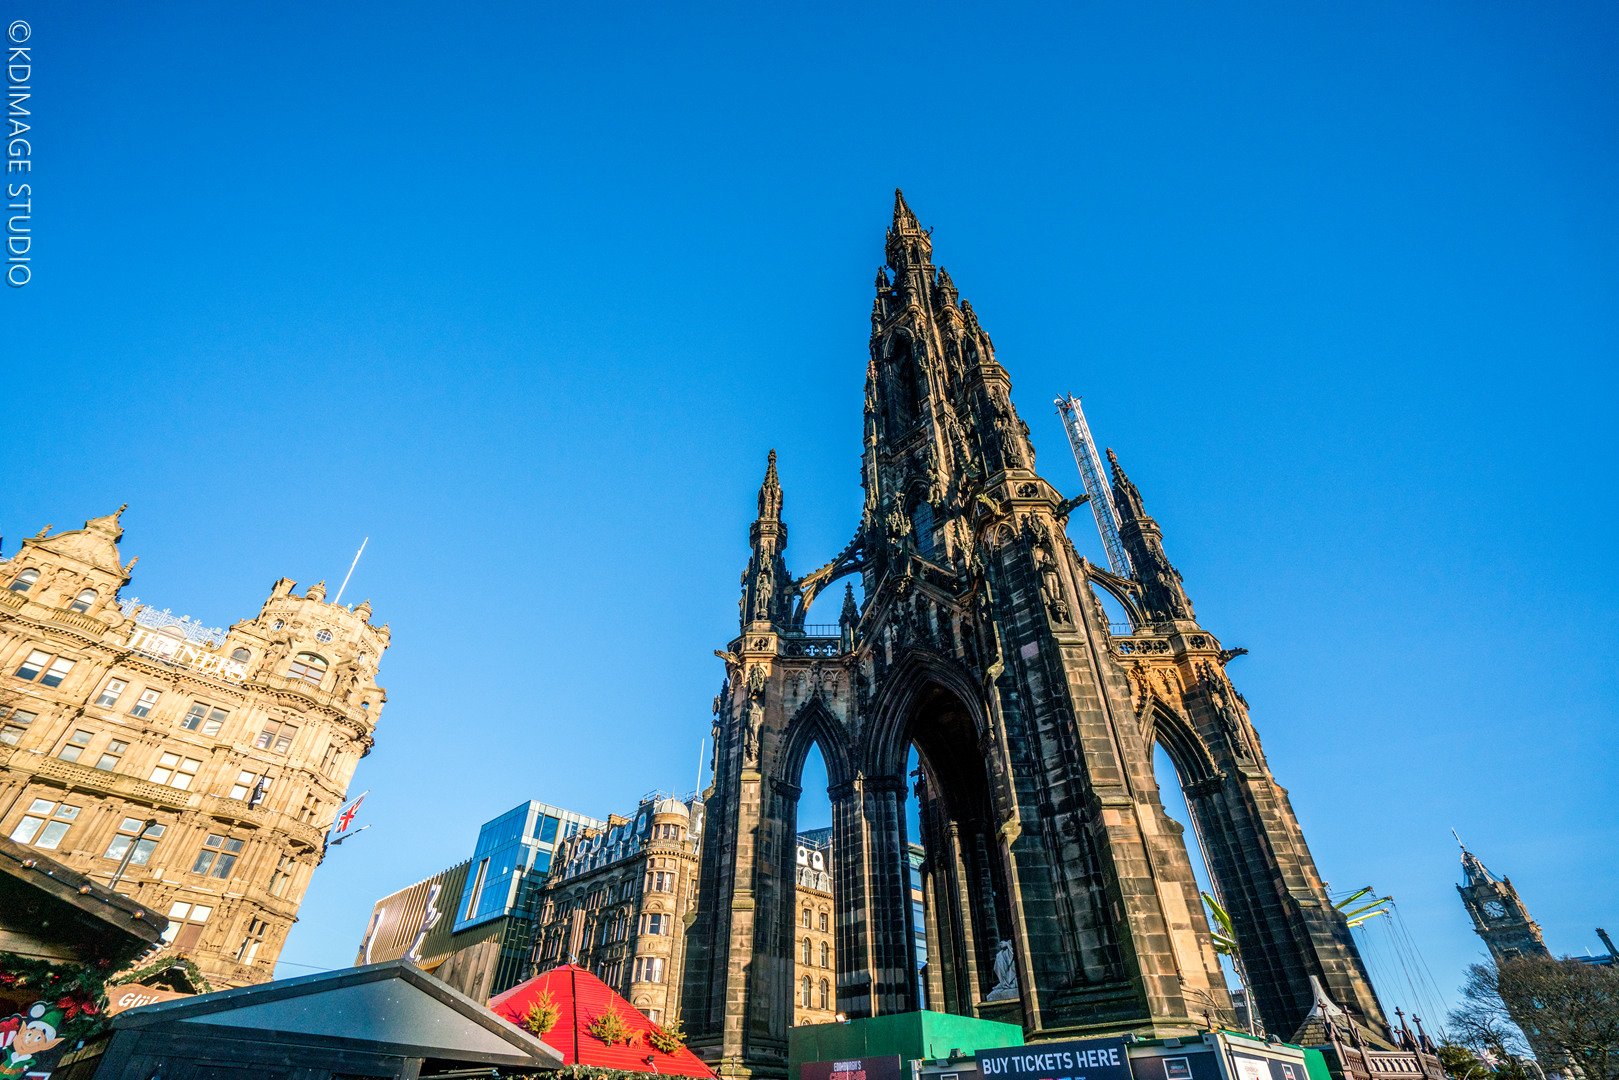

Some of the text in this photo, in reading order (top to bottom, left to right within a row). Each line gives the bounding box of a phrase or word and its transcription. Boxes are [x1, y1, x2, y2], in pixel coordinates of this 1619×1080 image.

[114, 627, 250, 681] JENNERS
[982, 1048, 1121, 1075] BUY TICKETS HERE
